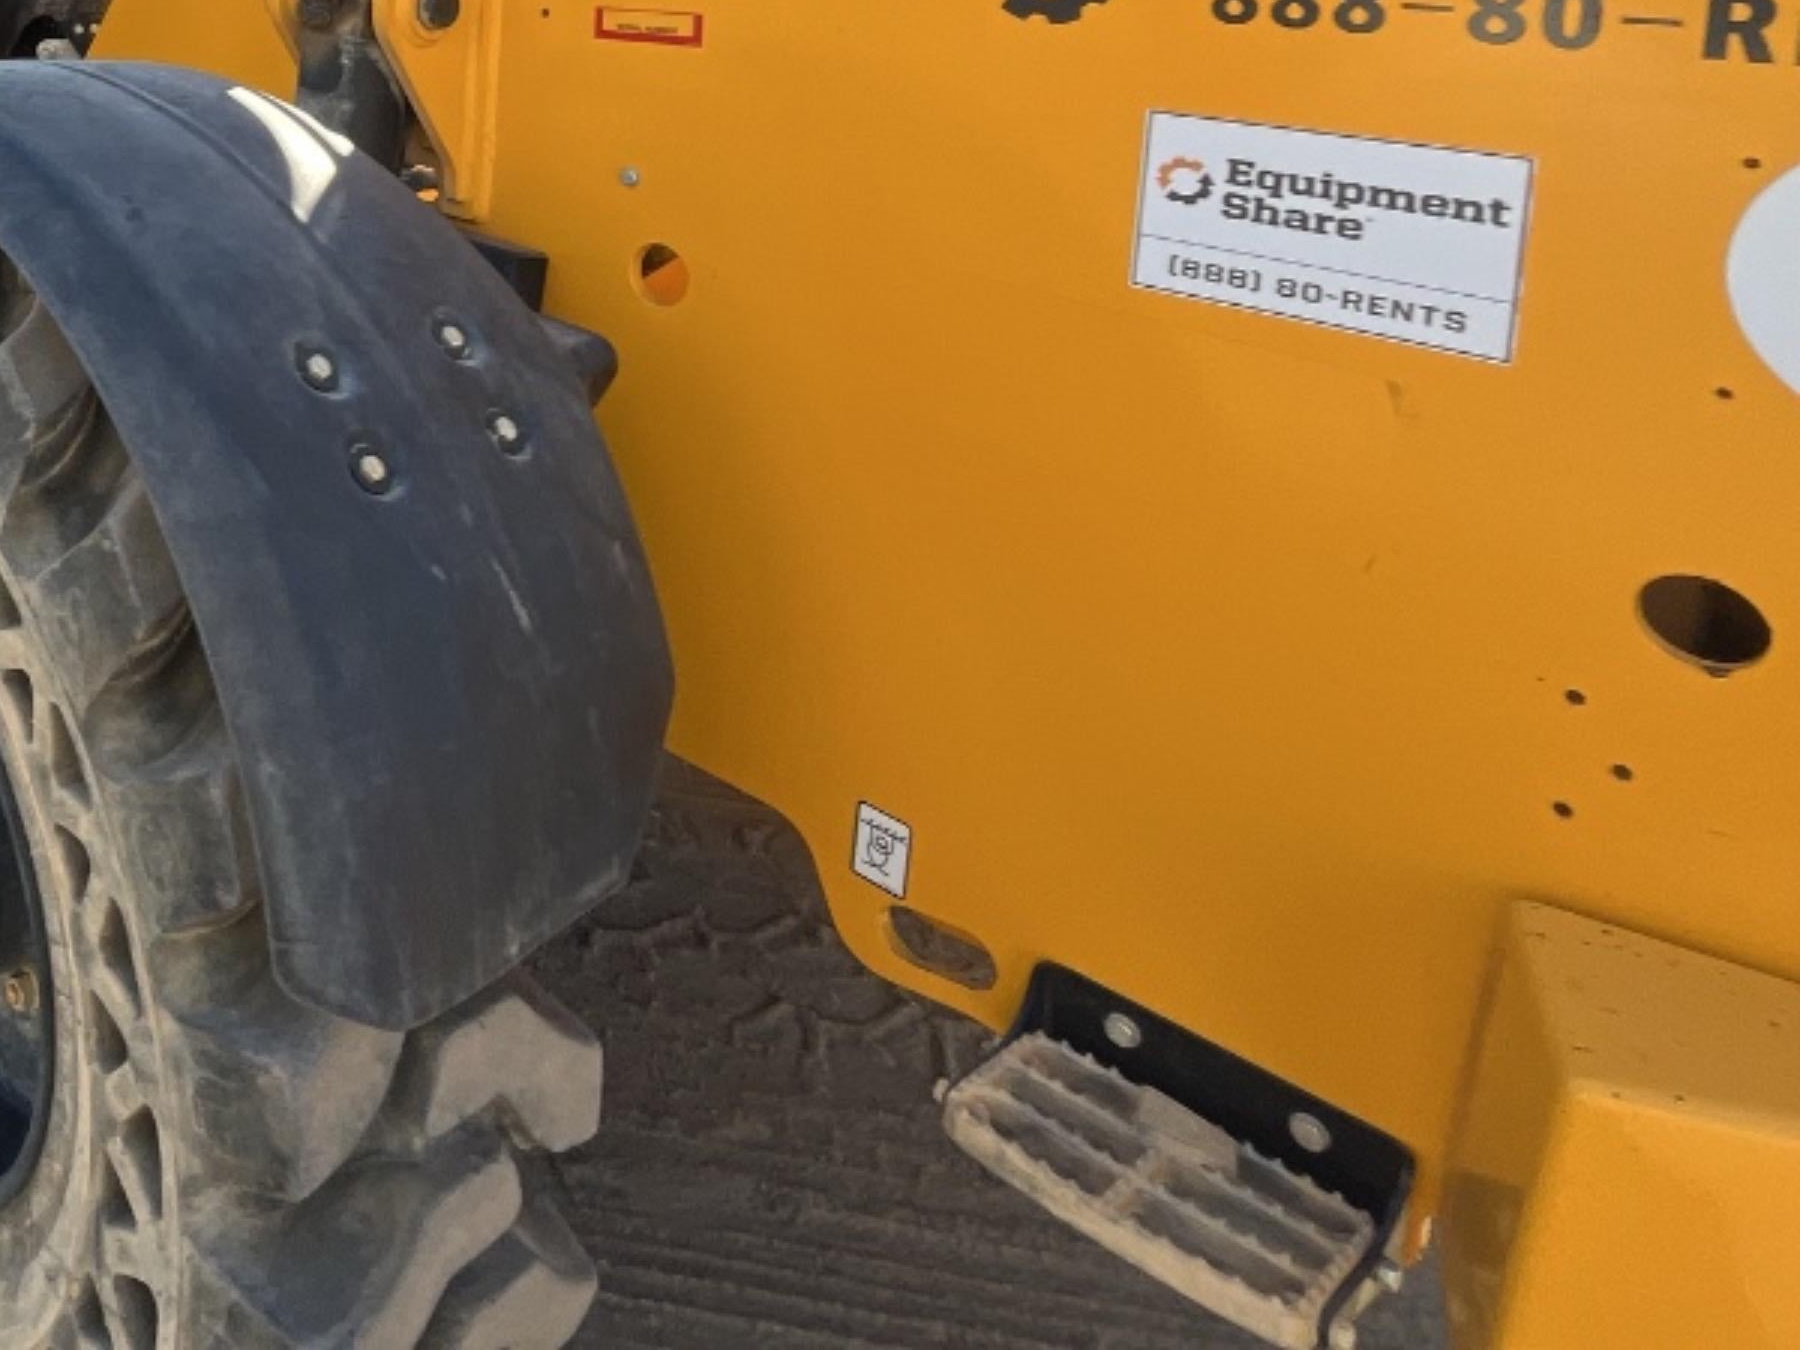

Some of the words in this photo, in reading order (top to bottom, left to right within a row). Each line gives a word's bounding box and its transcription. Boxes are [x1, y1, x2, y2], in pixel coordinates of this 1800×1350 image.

[1220, 190, 1364, 242] Share
[1225, 157, 1513, 229] Equipment
[1168, 253, 1262, 293] (888)
[1275, 277, 1469, 334] 80-RENTS
